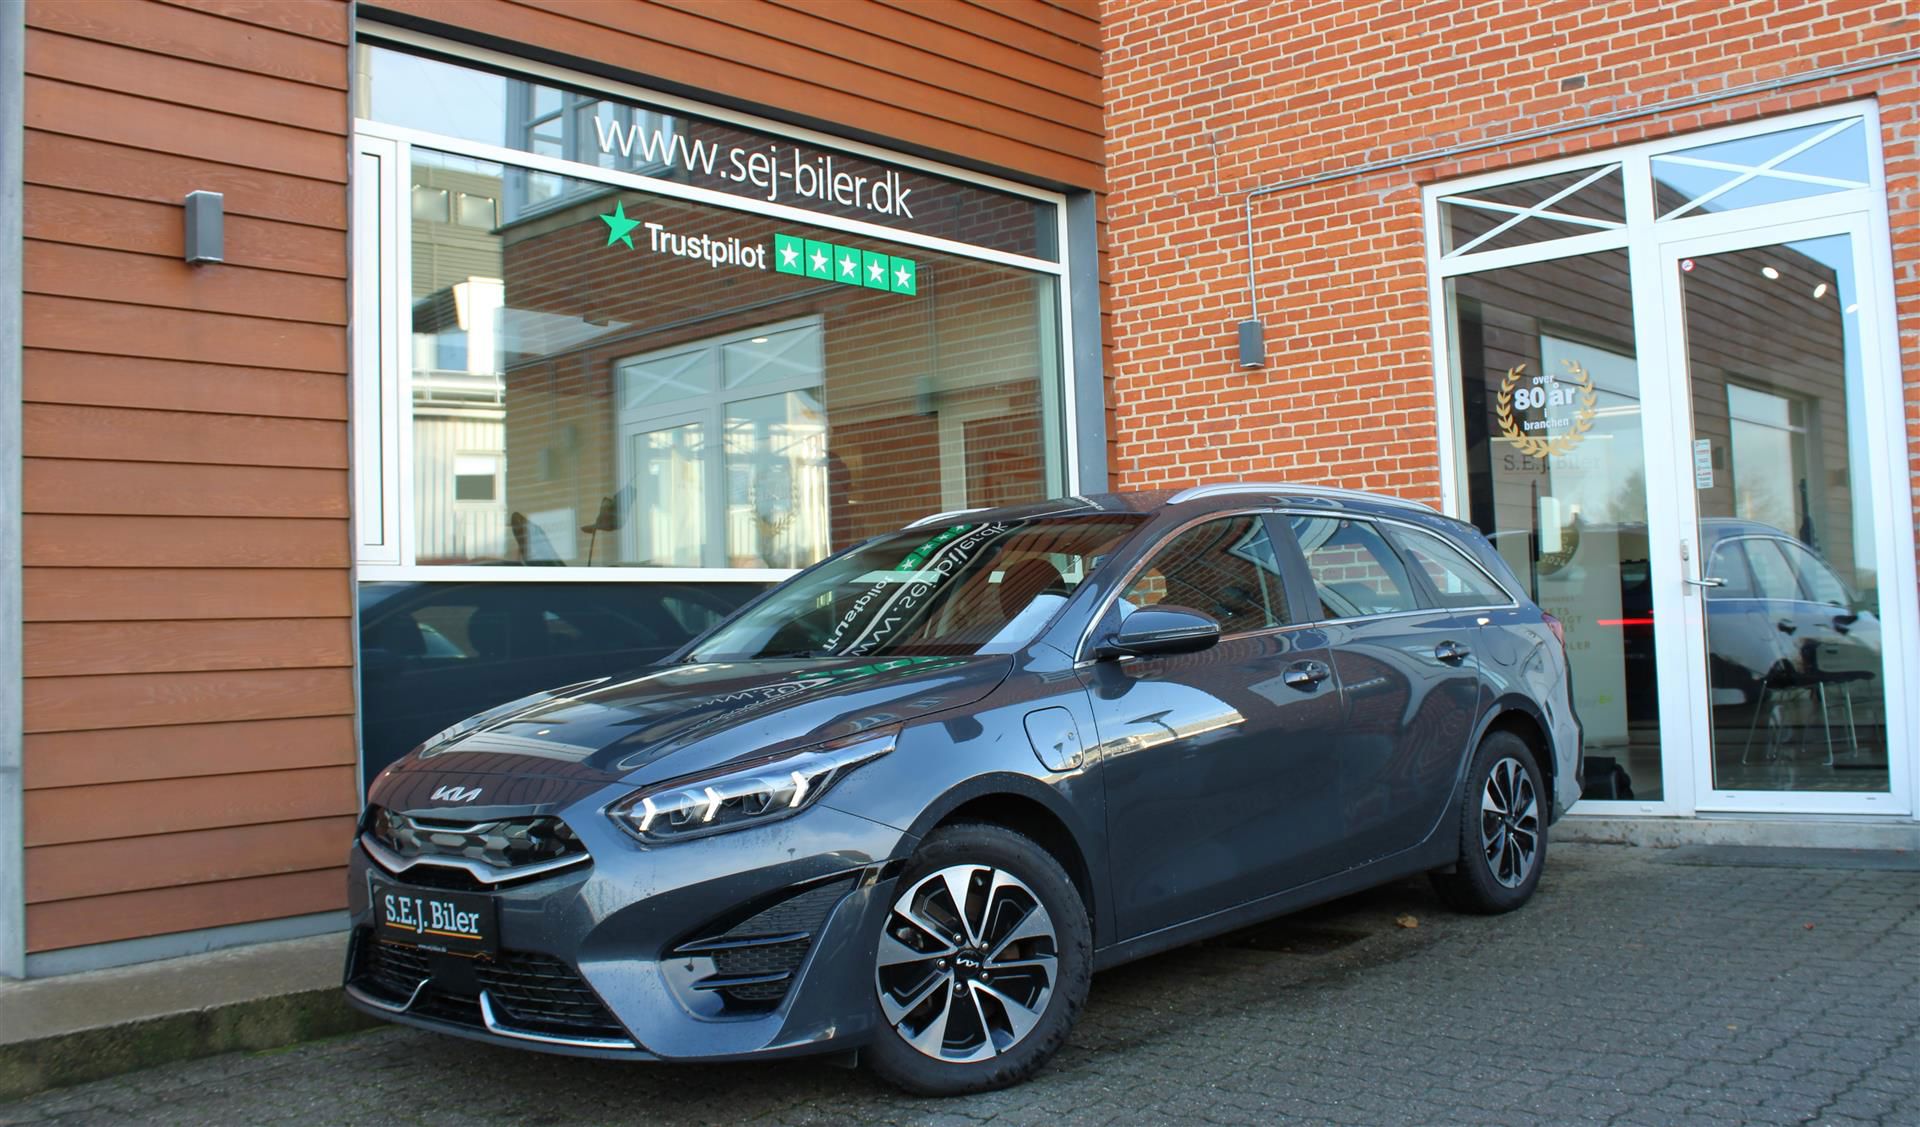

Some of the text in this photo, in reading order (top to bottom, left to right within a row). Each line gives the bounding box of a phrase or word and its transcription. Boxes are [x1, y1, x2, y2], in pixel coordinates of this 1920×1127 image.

[594, 116, 913, 218] www.sej-biler.dk
[645, 222, 766, 269] Trustpilot
[1532, 375, 1554, 385] over
[1514, 382, 1576, 411] 80 år
[1524, 418, 1569, 431] branchen
[1543, 408, 1548, 418] i
[385, 894, 480, 934] S.E.J. Biler
